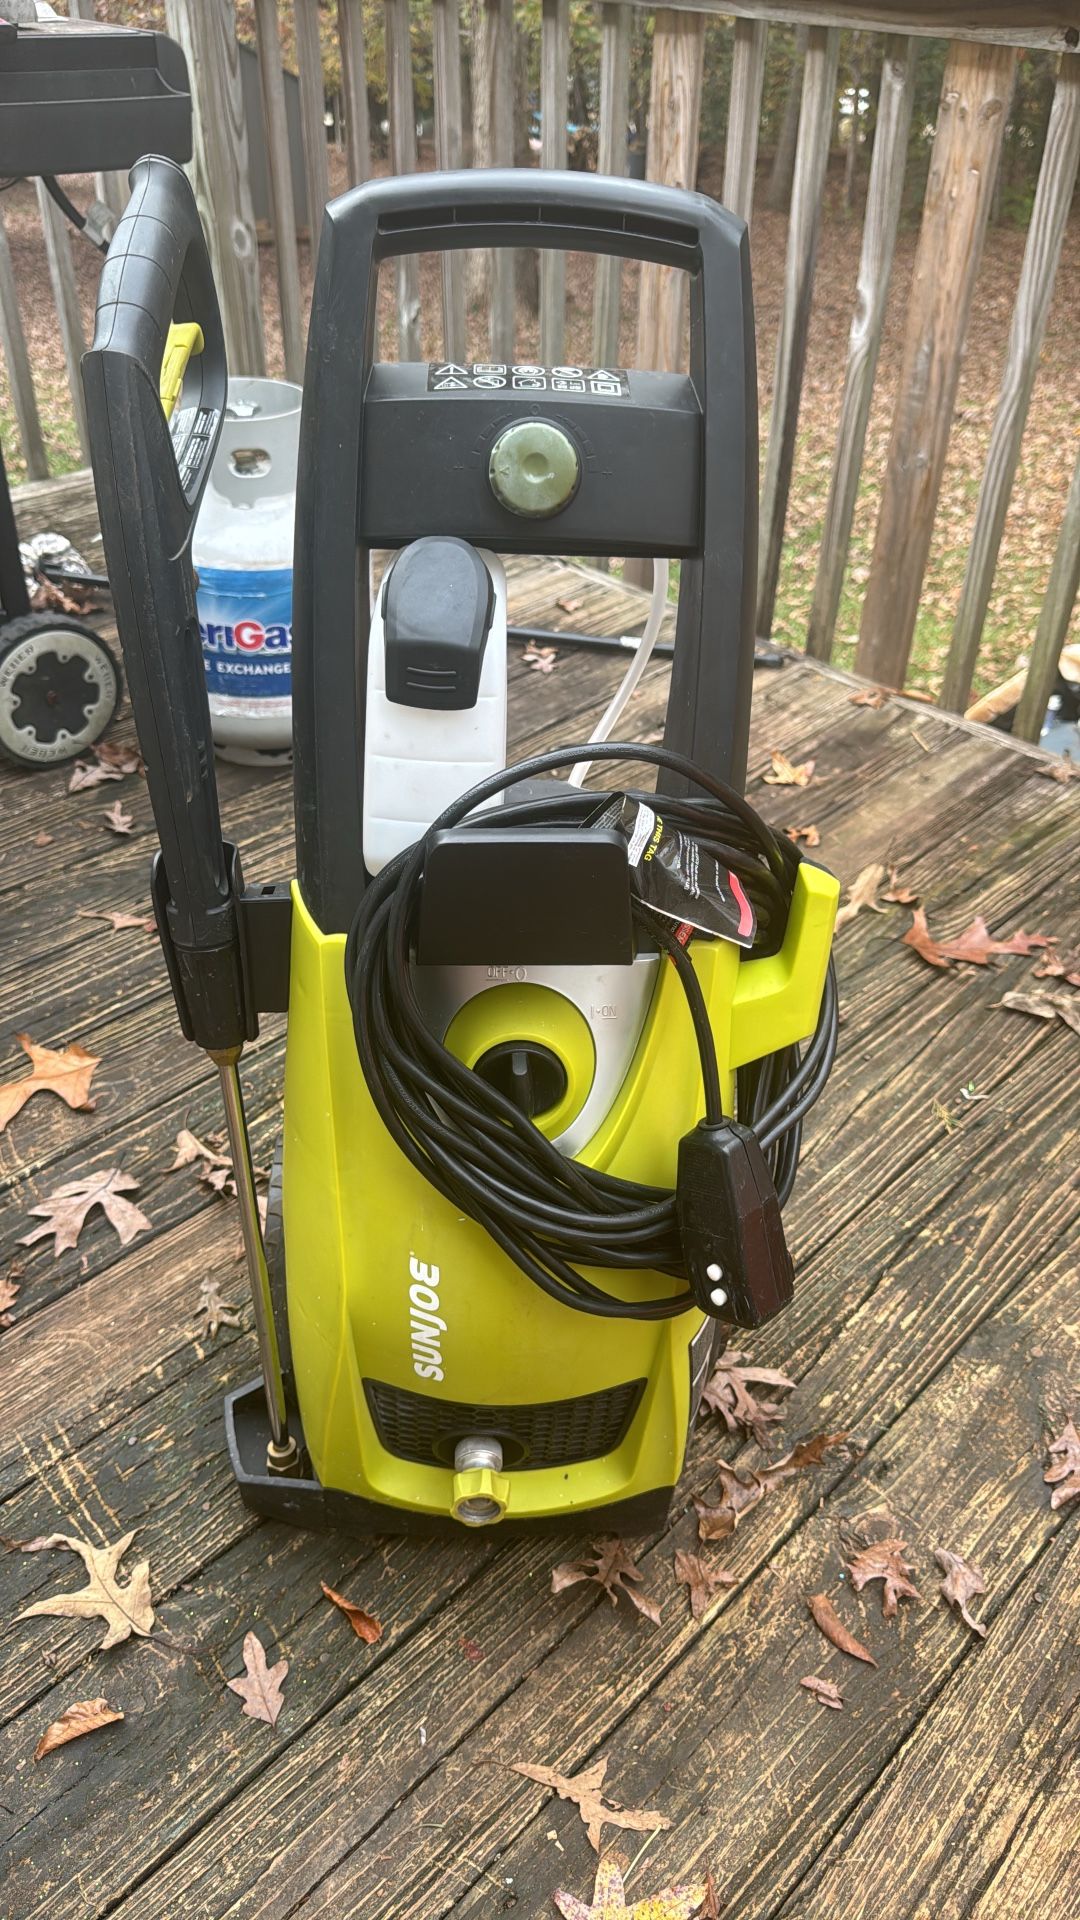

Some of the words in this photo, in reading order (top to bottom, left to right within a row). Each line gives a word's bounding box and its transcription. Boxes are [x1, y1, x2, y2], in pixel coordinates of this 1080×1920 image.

[217, 661, 291, 676] EXCHANGE
[653, 824, 663, 844] THIS
[644, 844, 658, 862] TAG
[487, 967, 508, 978] OFF
[601, 1005, 617, 1017] ON
